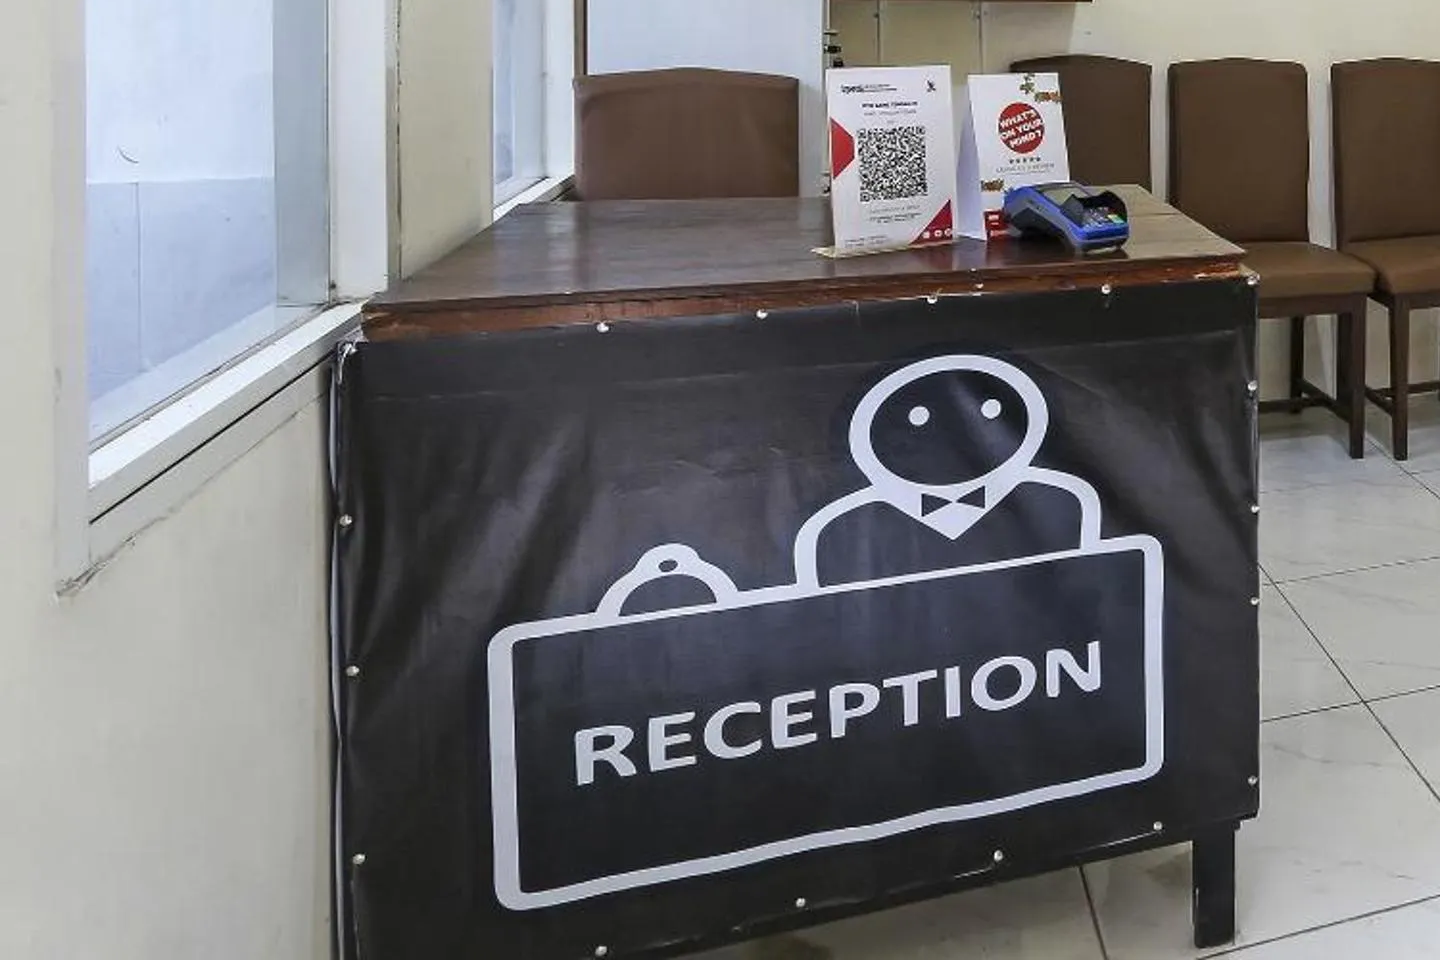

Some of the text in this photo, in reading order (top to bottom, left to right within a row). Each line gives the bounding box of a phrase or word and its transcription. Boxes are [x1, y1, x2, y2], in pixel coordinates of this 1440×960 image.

[1001, 118, 1044, 140] ON YOUR
[574, 640, 1102, 786] RECEPTION
